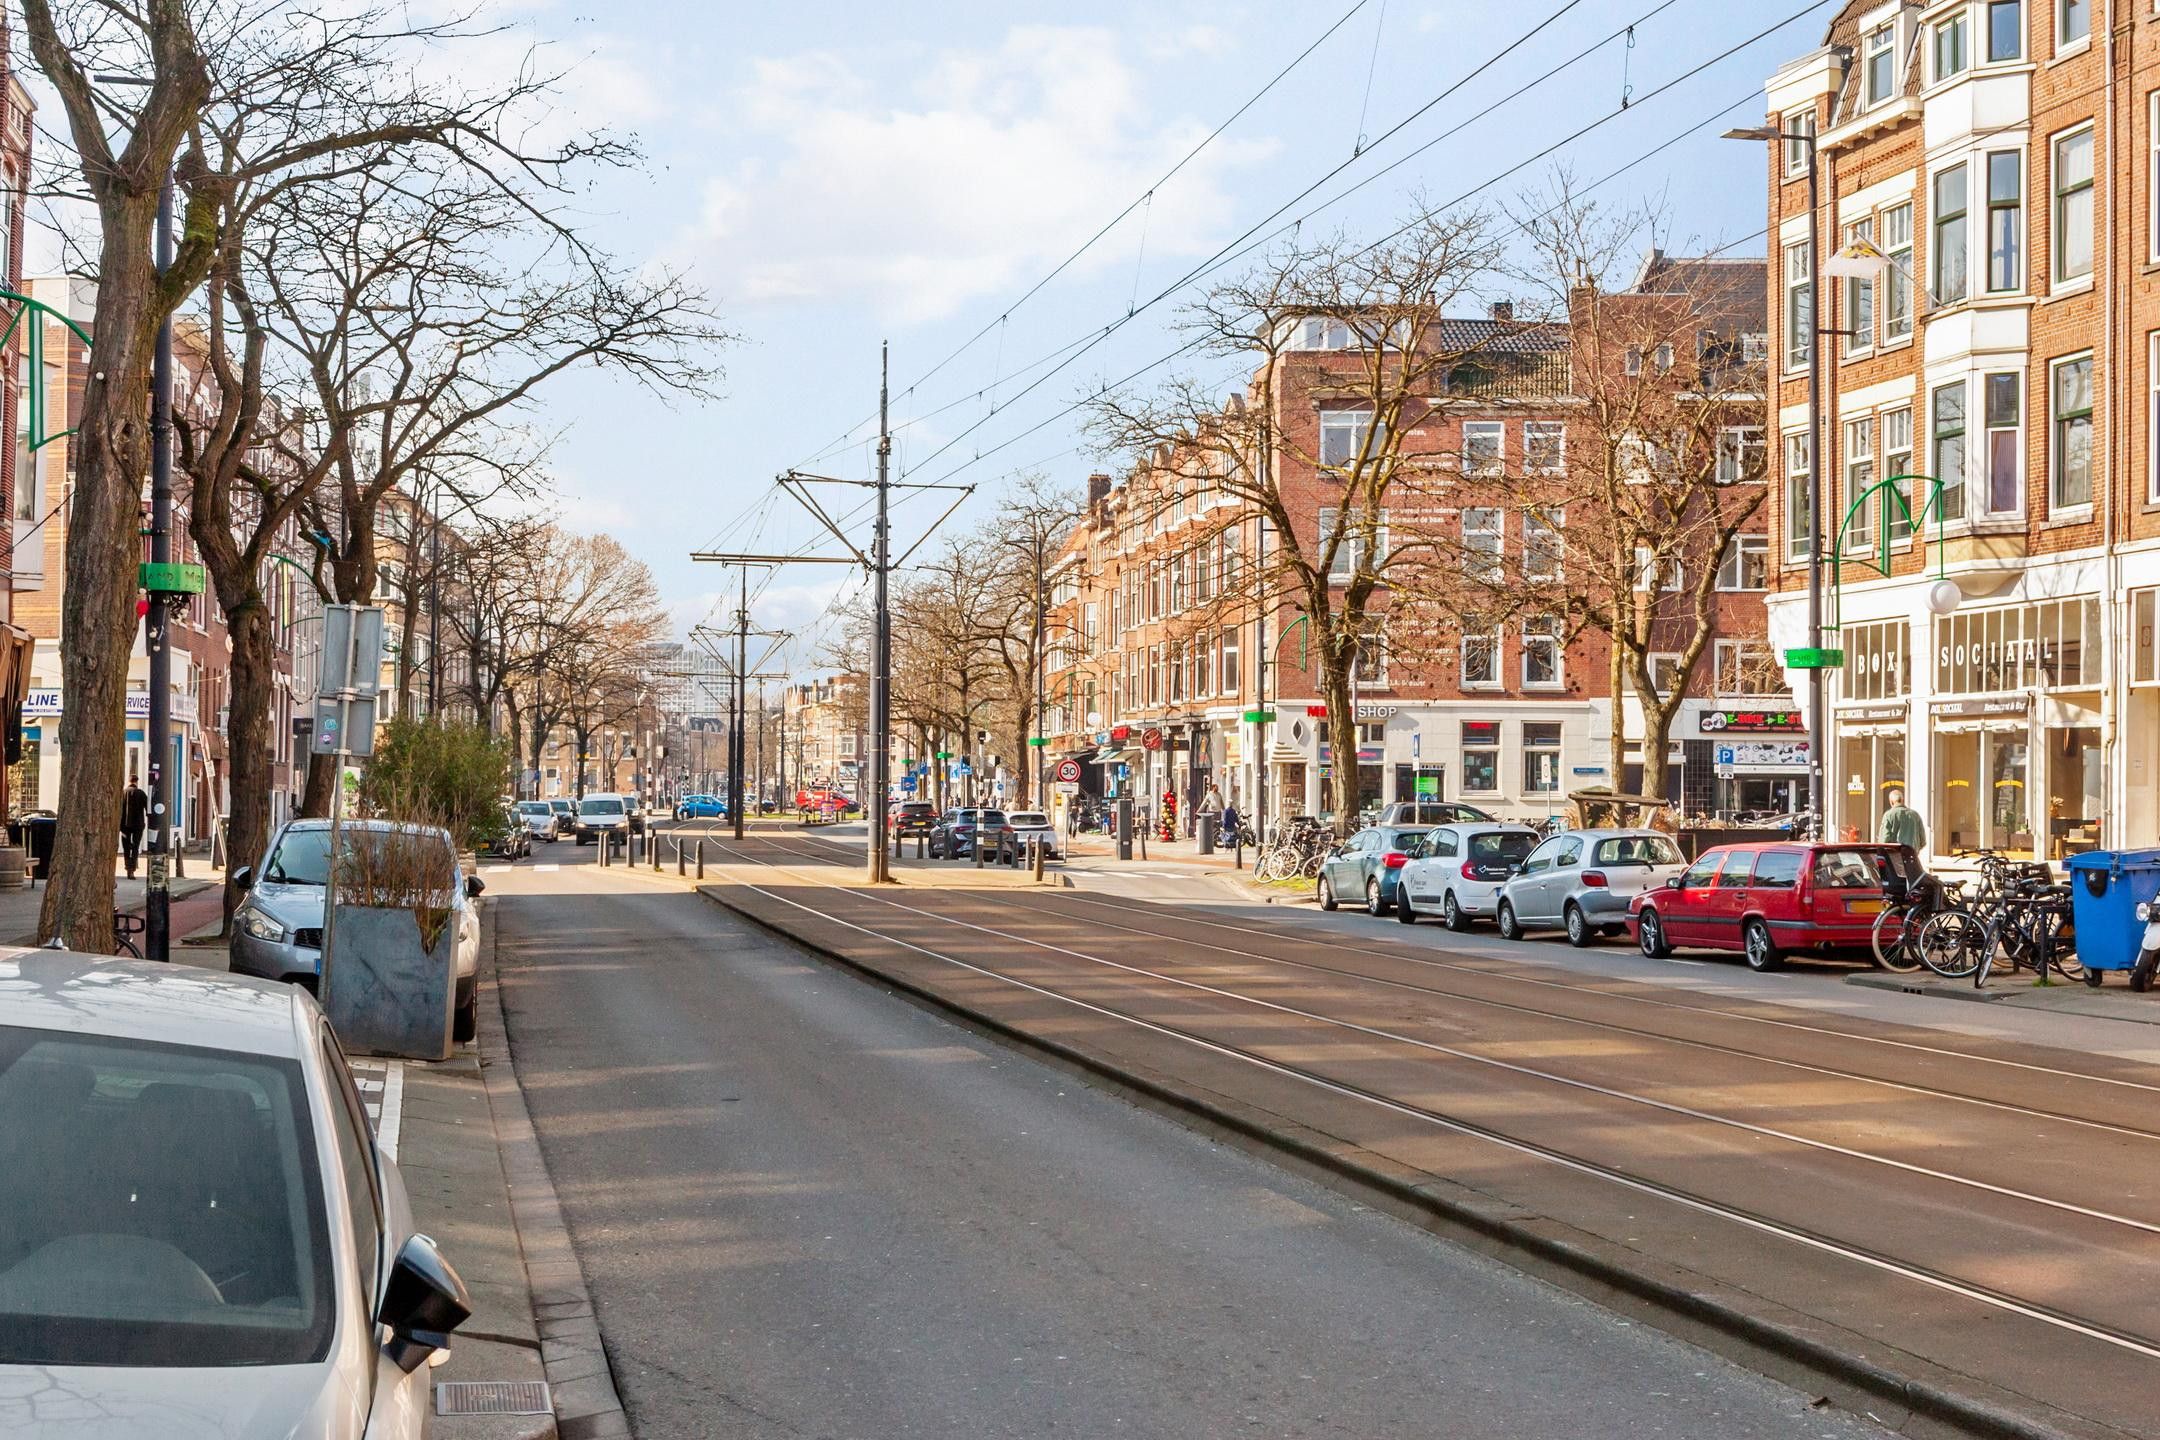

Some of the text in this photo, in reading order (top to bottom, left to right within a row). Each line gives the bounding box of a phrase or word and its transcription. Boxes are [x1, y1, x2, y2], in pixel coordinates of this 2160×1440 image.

[1940, 637, 2052, 668] SOCIAAL
[1858, 651, 1896, 675] BOX
[27, 694, 58, 706] LINE
[126, 697, 150, 708] RVICE
[1358, 706, 1397, 718] SHOP
[1722, 751, 1731, 762] P
[1063, 766, 1076, 776] 30
